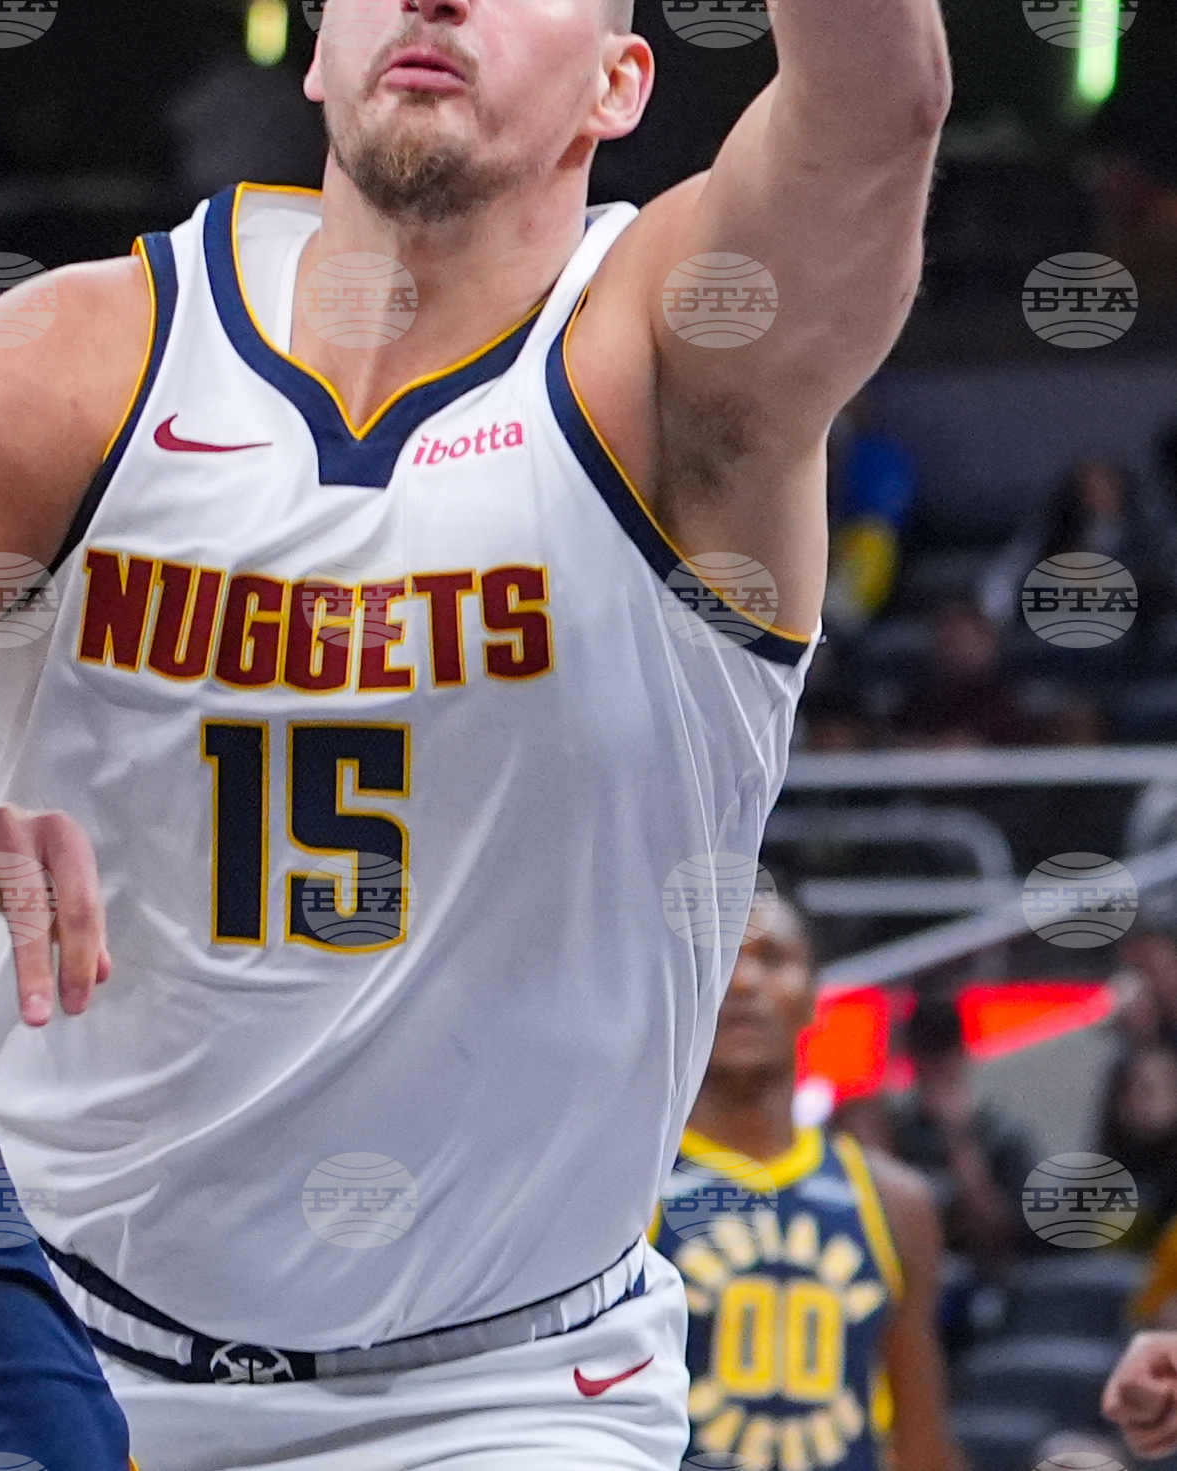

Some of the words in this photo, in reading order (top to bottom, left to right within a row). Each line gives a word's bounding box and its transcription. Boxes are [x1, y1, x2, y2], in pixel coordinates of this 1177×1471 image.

[413, 421, 523, 465] ibotta
[76, 547, 555, 694] NUGGETS
[199, 718, 411, 956] 15
[716, 1276, 845, 1400] 00
